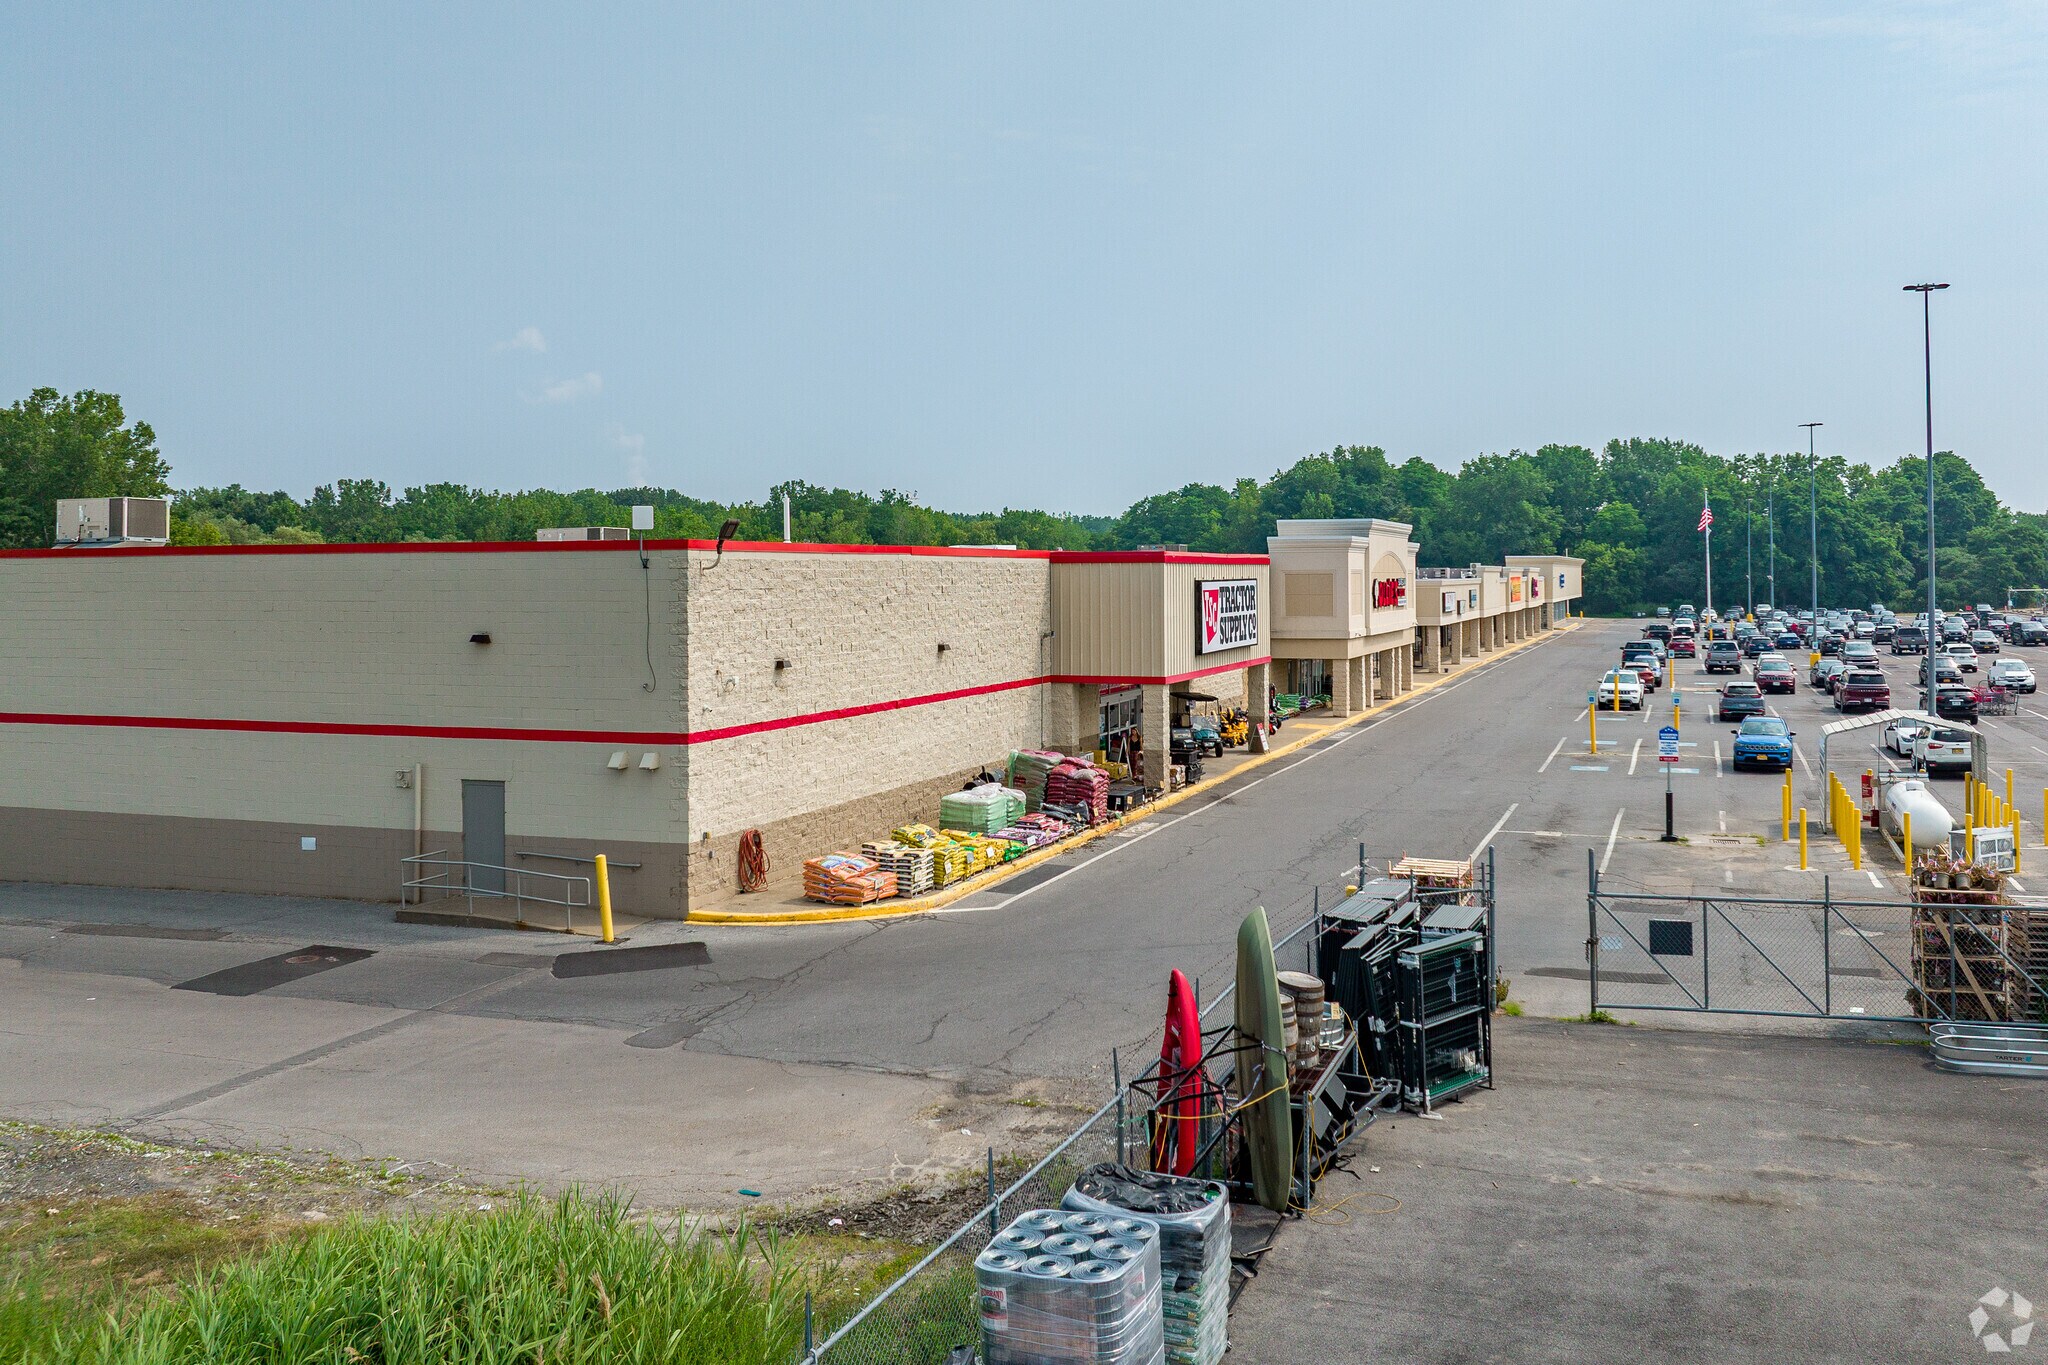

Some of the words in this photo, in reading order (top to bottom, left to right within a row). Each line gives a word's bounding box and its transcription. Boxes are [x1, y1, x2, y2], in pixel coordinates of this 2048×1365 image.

[1204, 591, 1217, 633] TSC
[1219, 585, 1256, 613] TRACTOR
[1219, 614, 1248, 645] SUPPLY
